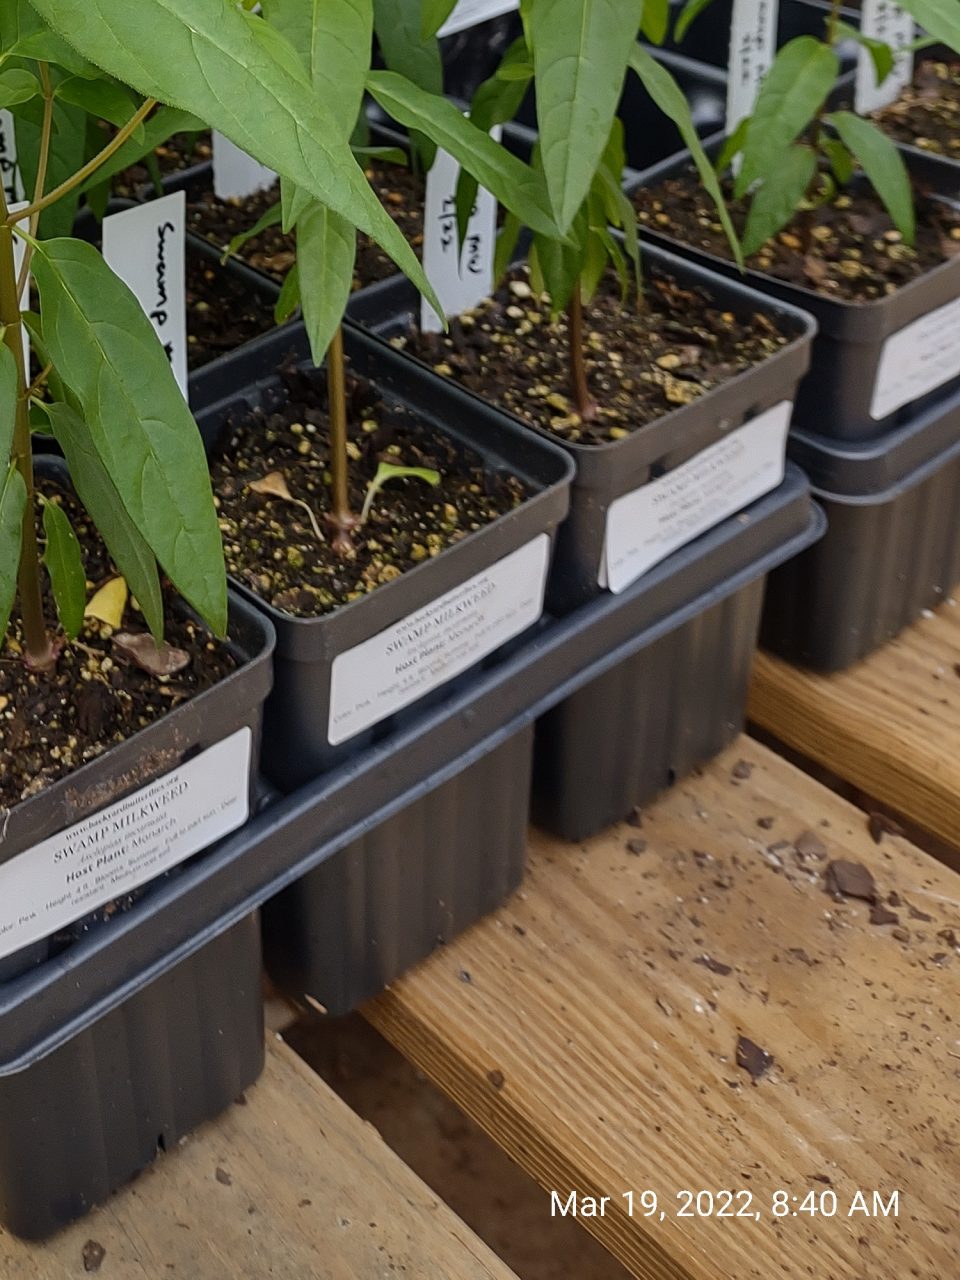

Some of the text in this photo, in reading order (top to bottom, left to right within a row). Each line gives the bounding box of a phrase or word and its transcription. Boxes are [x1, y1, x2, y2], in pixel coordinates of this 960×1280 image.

[53, 781, 188, 864] SWAMP MILKWEED
[66, 863, 93, 883] Host
[132, 817, 176, 848] Monarch
